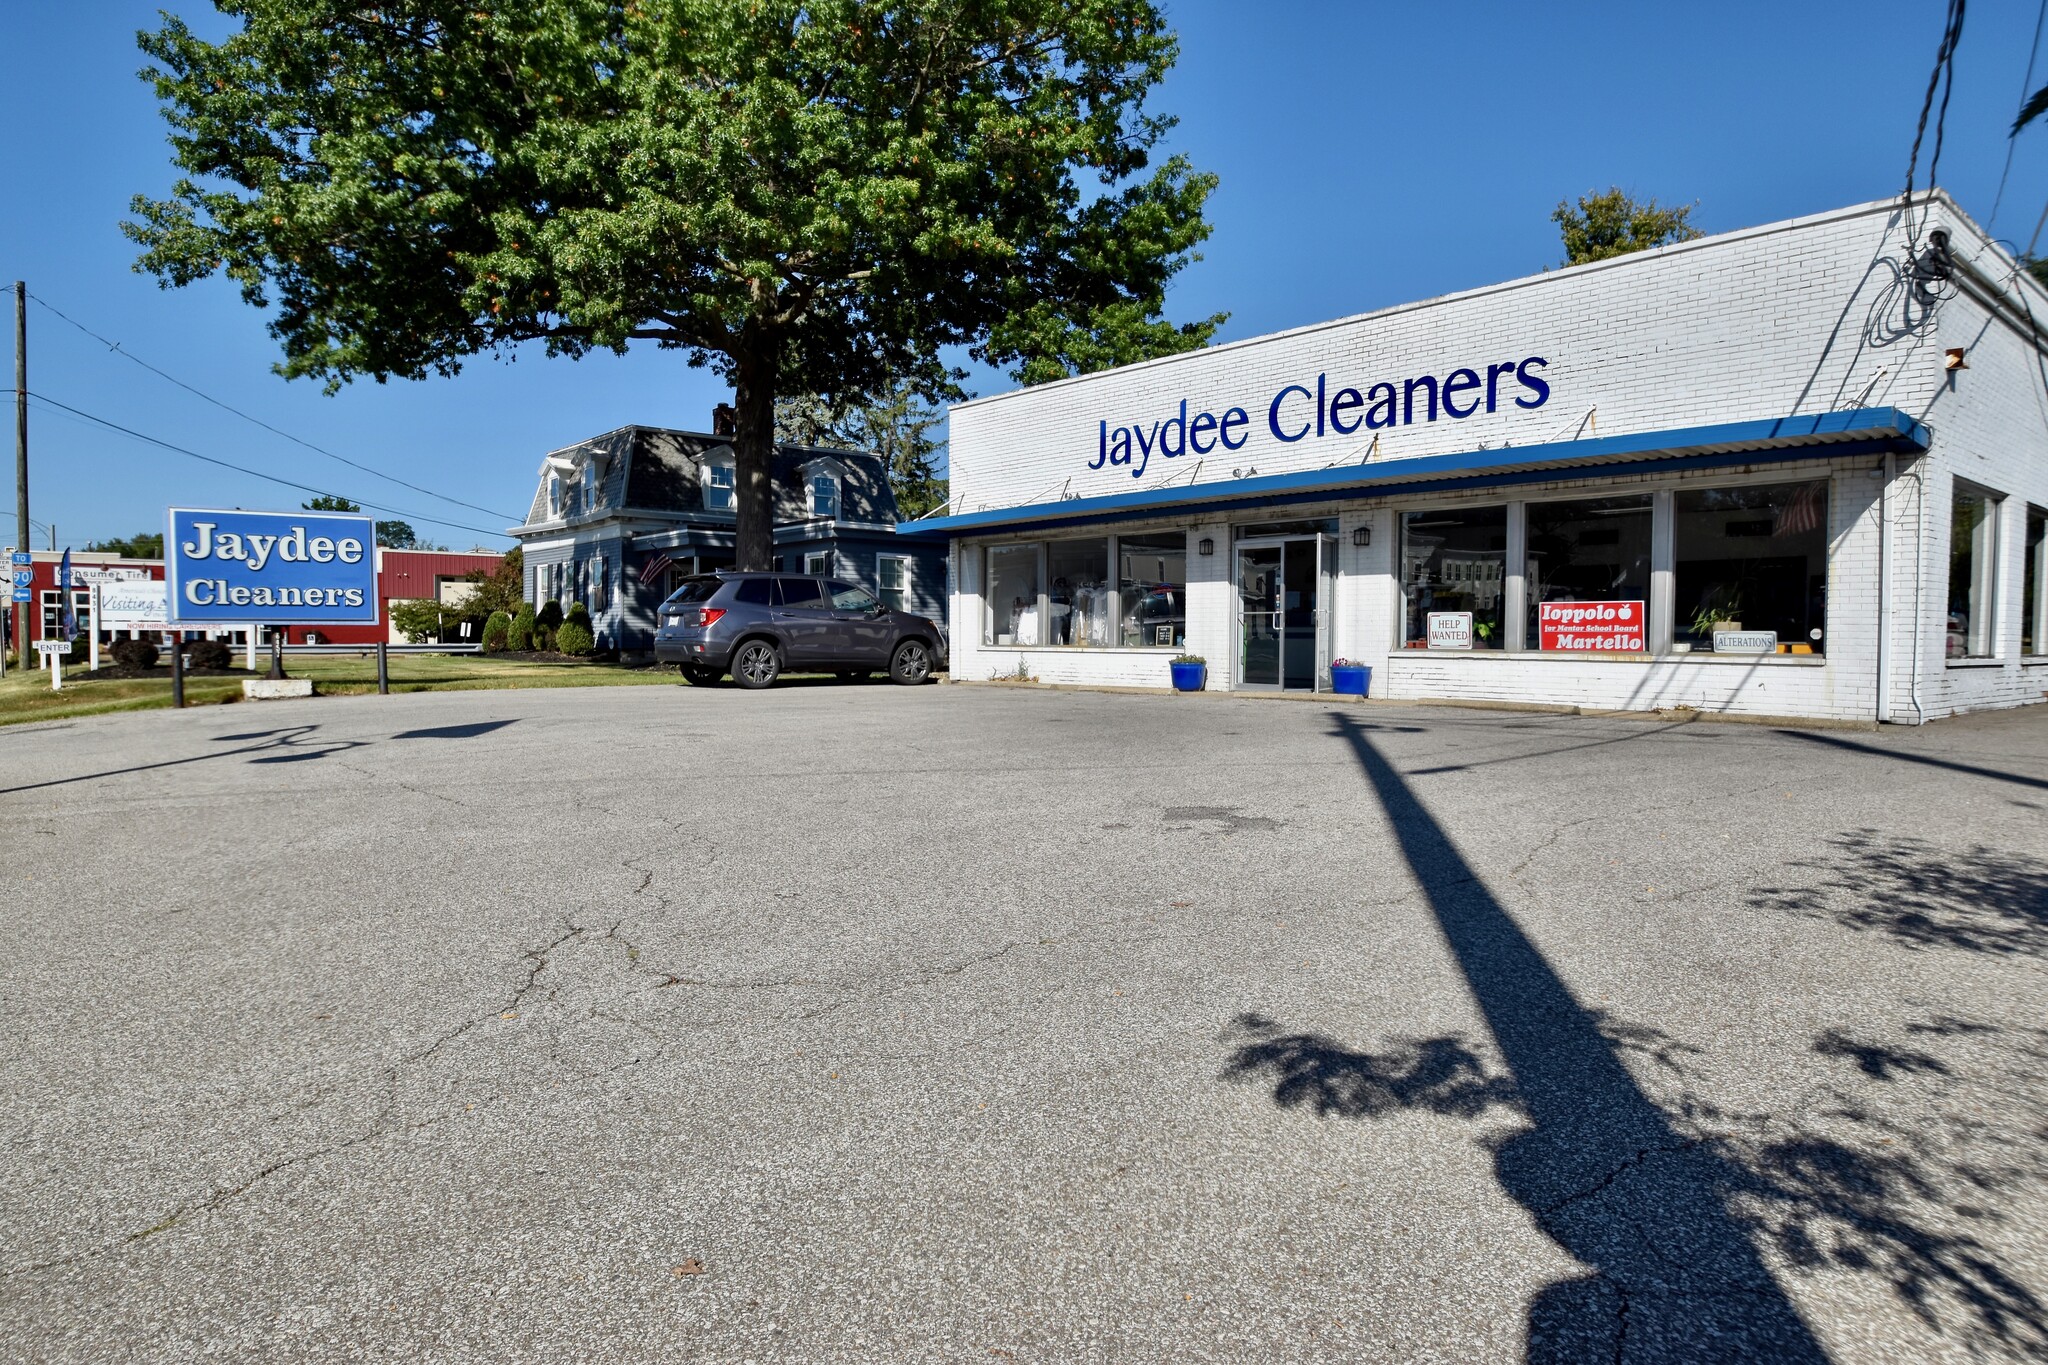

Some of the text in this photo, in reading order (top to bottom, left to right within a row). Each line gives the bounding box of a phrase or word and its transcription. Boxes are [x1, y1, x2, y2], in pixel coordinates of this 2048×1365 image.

[1087, 356, 1551, 478] Jaydee Cleaners
[183, 521, 364, 571] Jaydee
[15, 554, 27, 562] TO
[13, 572, 30, 582] 90
[126, 570, 148, 579] Tire
[185, 578, 365, 607] Cleaners
[102, 595, 154, 616] Visiting
[1542, 604, 1616, 624] Ioppolo
[127, 622, 145, 630] NOW
[1438, 619, 1461, 629] HELP
[1544, 624, 1639, 632] for Mentor School Board
[1431, 631, 1468, 640] WANTED
[1556, 634, 1642, 650] Martello
[1717, 637, 1773, 648] ALTERATIONS
[40, 643, 70, 652] ENTER
